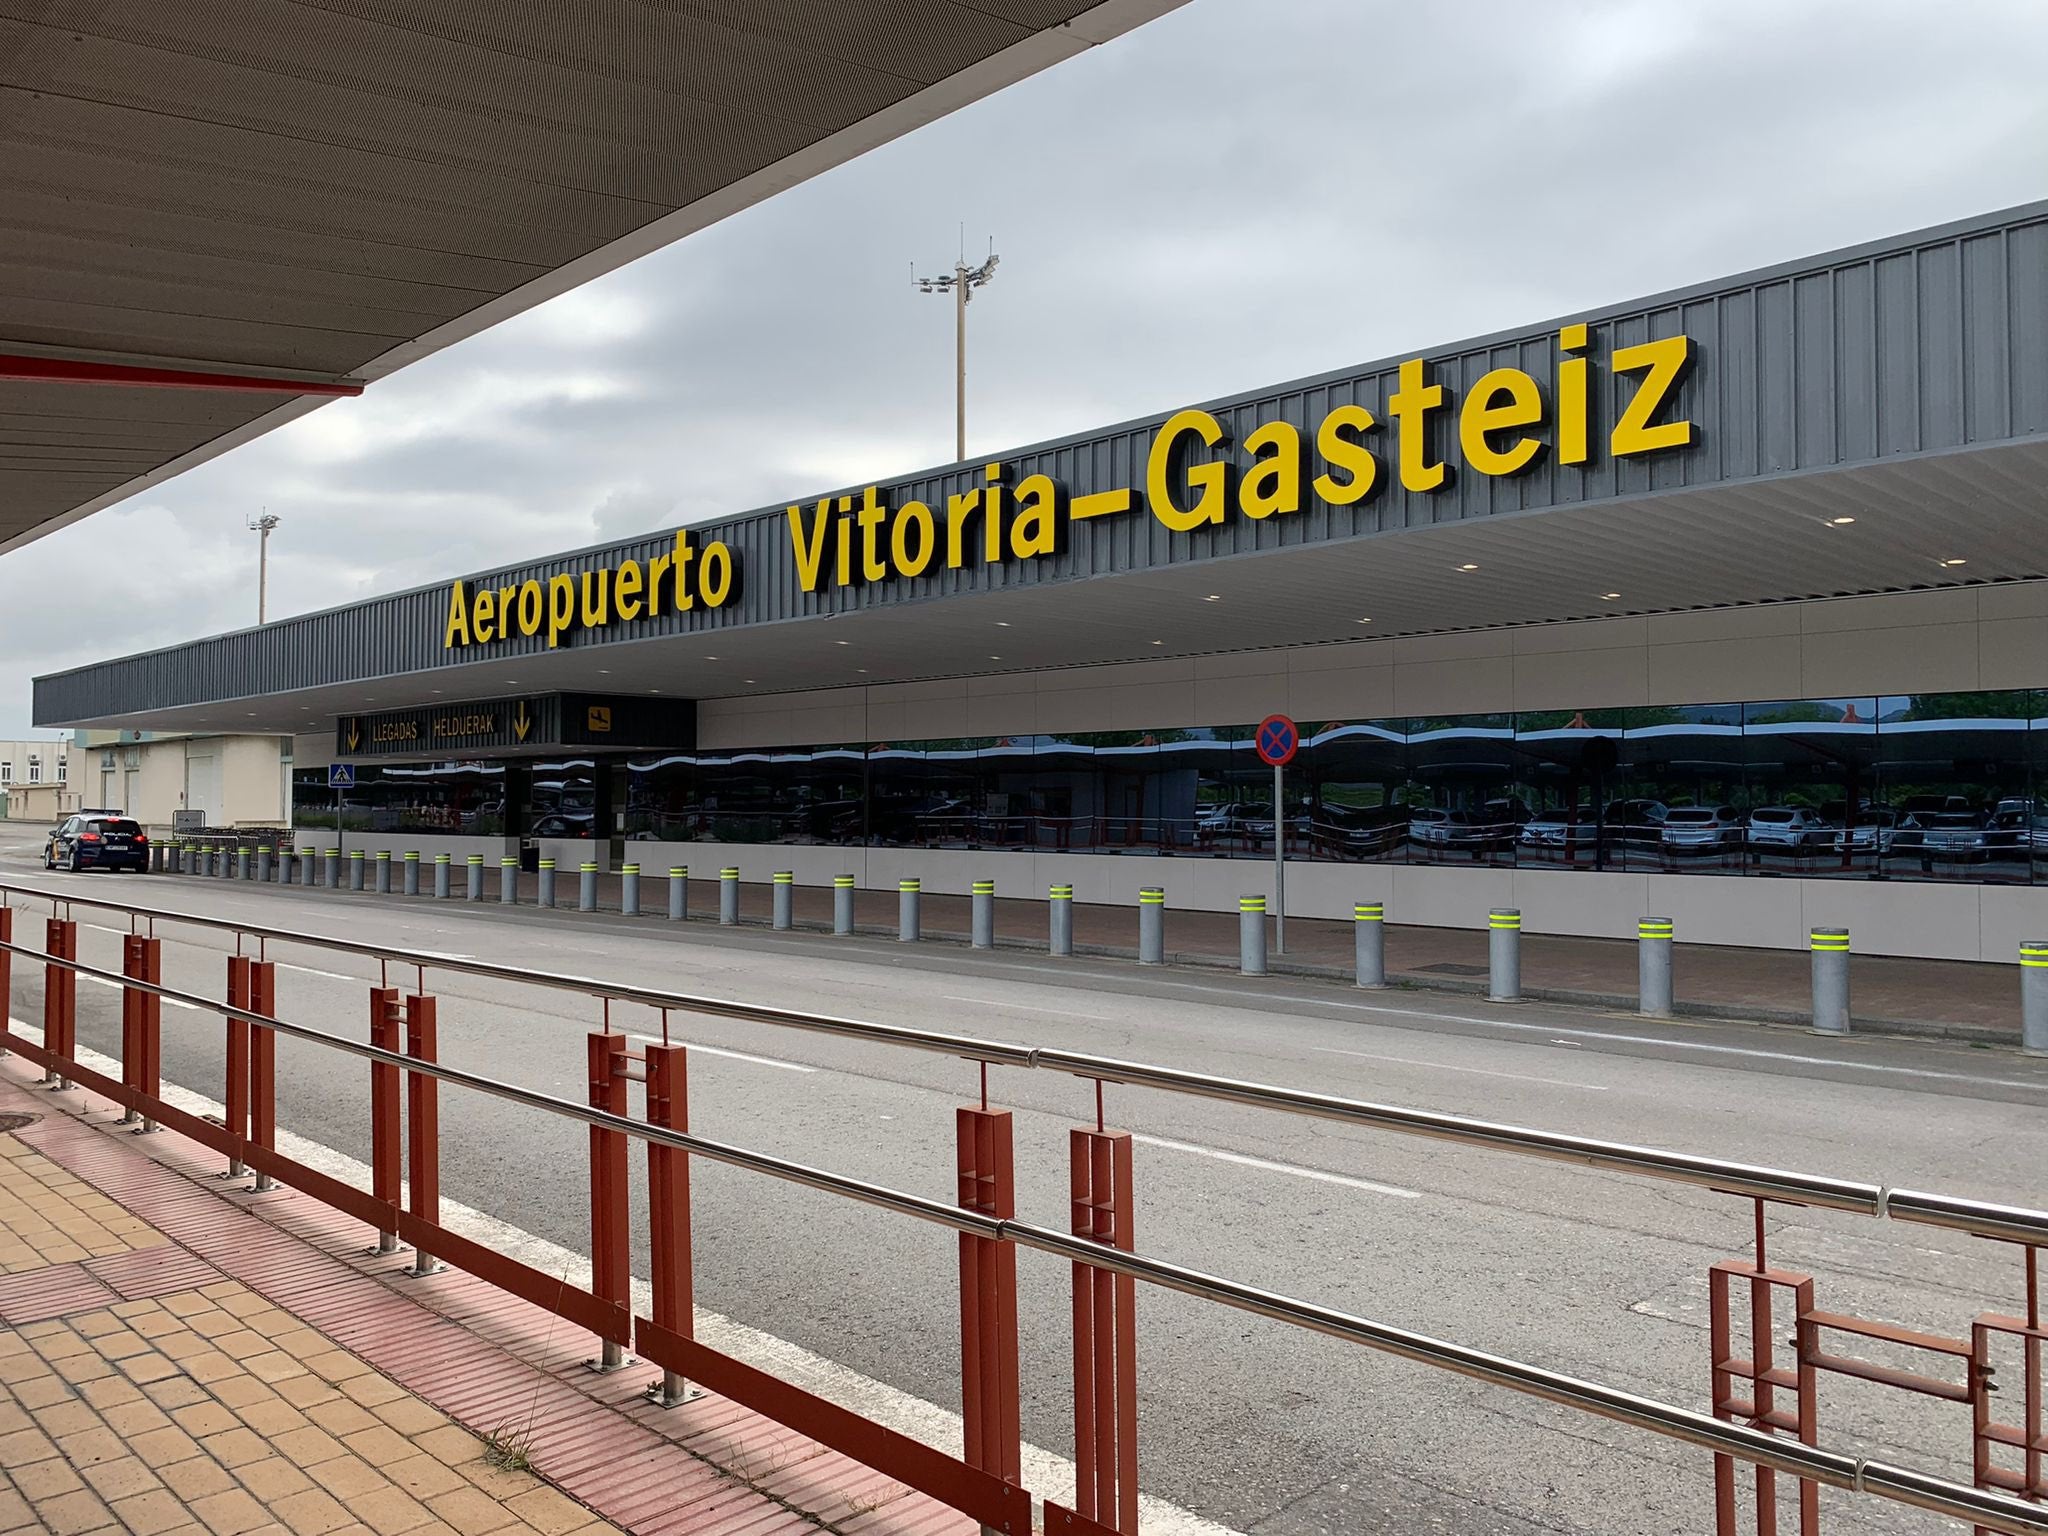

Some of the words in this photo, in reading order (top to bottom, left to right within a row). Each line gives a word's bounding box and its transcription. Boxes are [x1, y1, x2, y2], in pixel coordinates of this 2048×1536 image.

[445, 529, 733, 648] Aeropuerto
[373, 721, 417, 741] LLEGADAS
[434, 714, 494, 737] HELDUERAK
